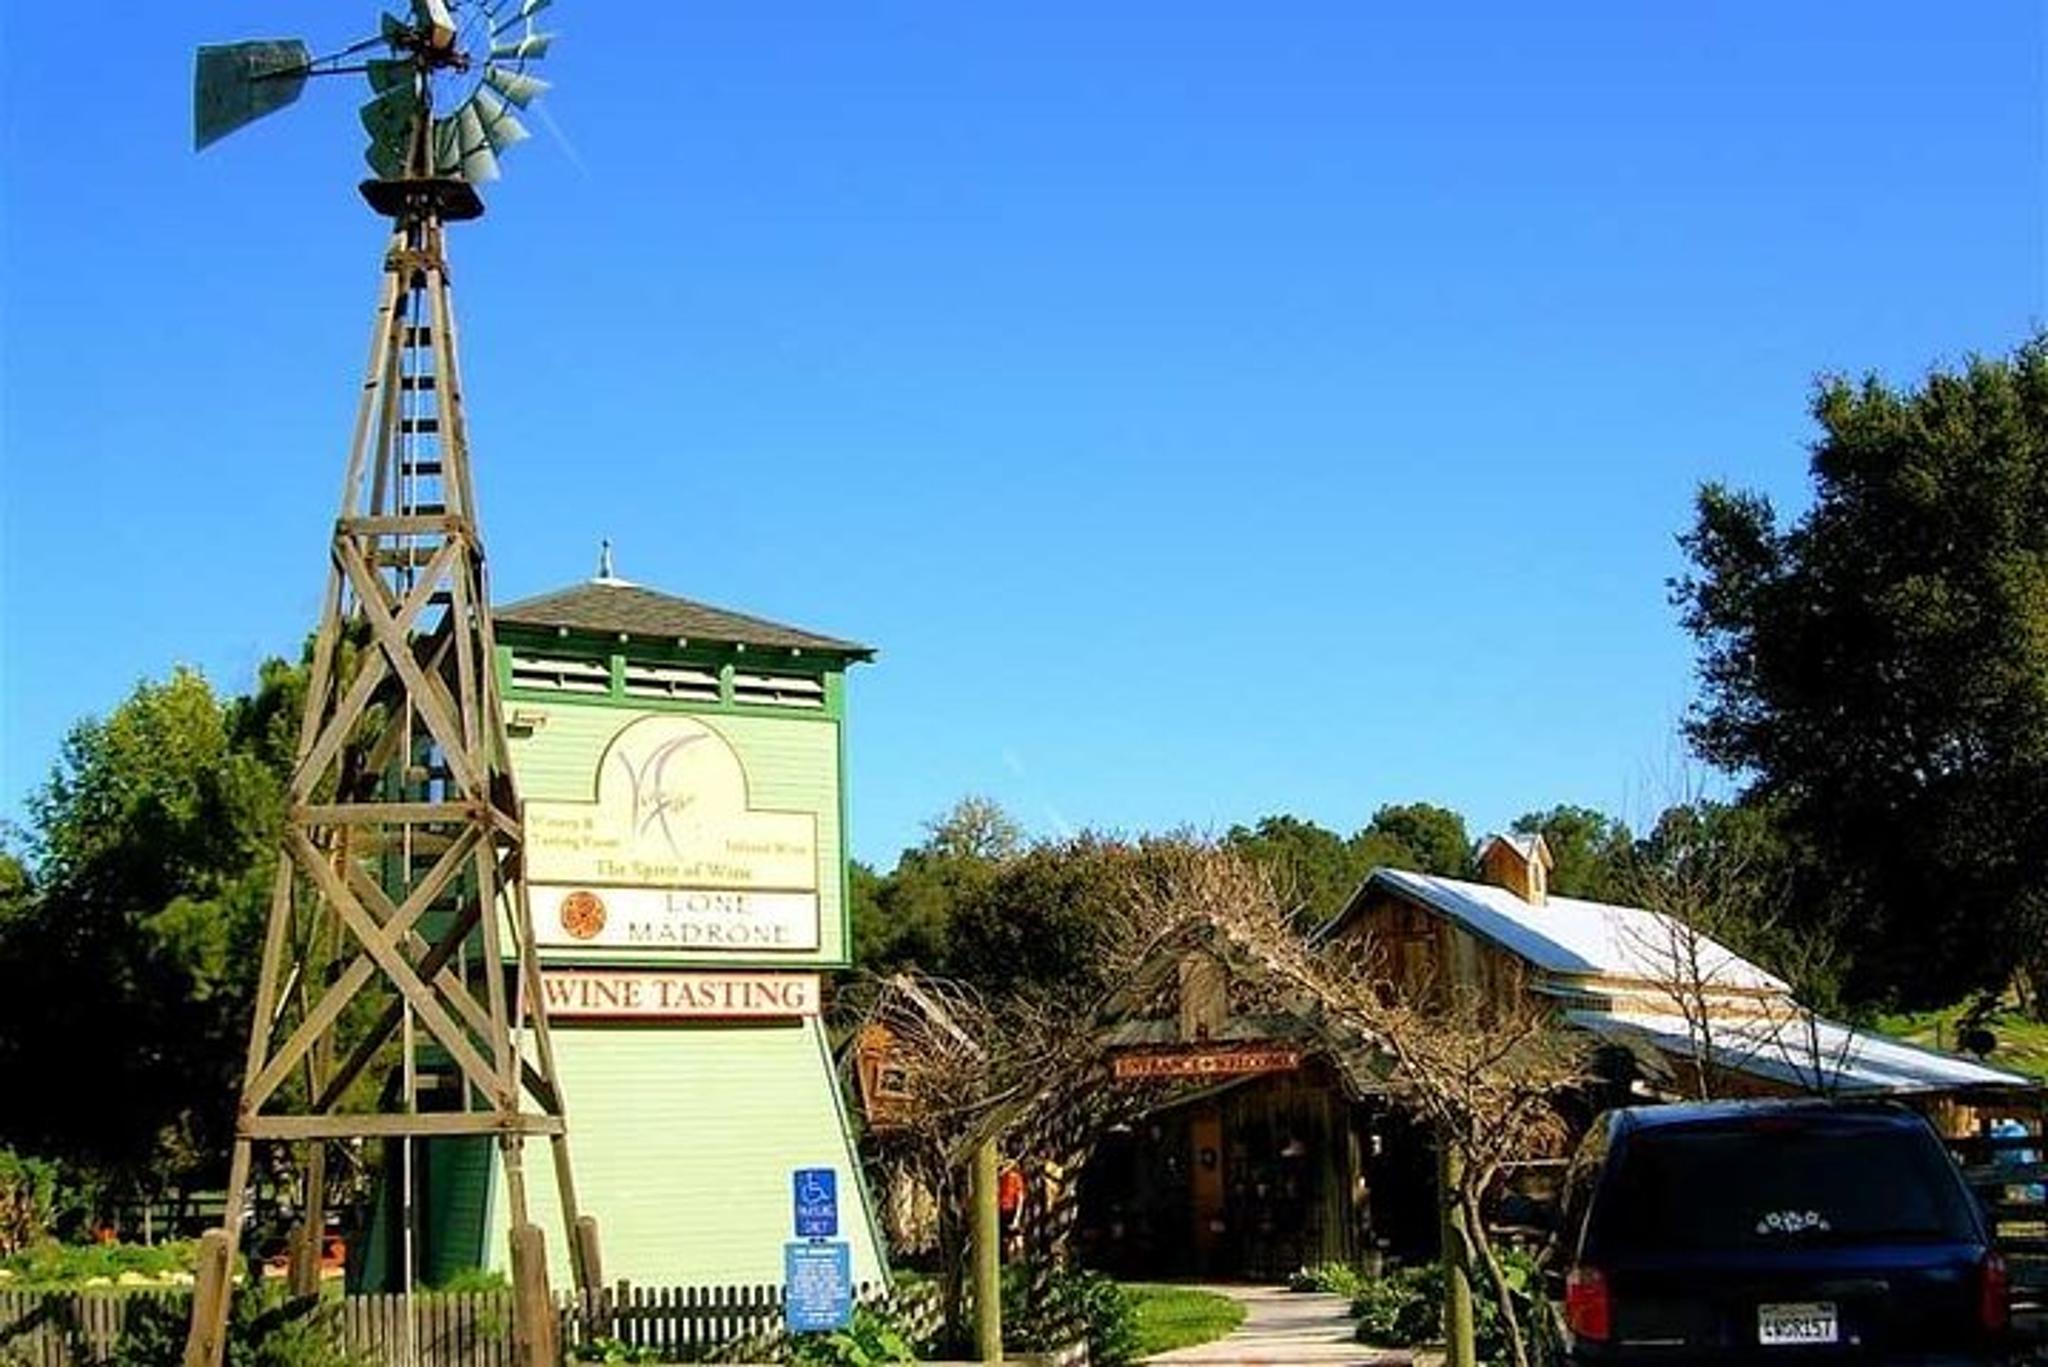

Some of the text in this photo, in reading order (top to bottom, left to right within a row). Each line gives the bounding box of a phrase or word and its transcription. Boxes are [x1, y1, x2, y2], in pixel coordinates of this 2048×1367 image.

[594, 860, 625, 875] The
[683, 861, 704, 876] of
[705, 862, 752, 879] Wine
[666, 894, 750, 913] LONE
[628, 922, 790, 943] MADRONE
[544, 979, 806, 1009] WINE TASTING
